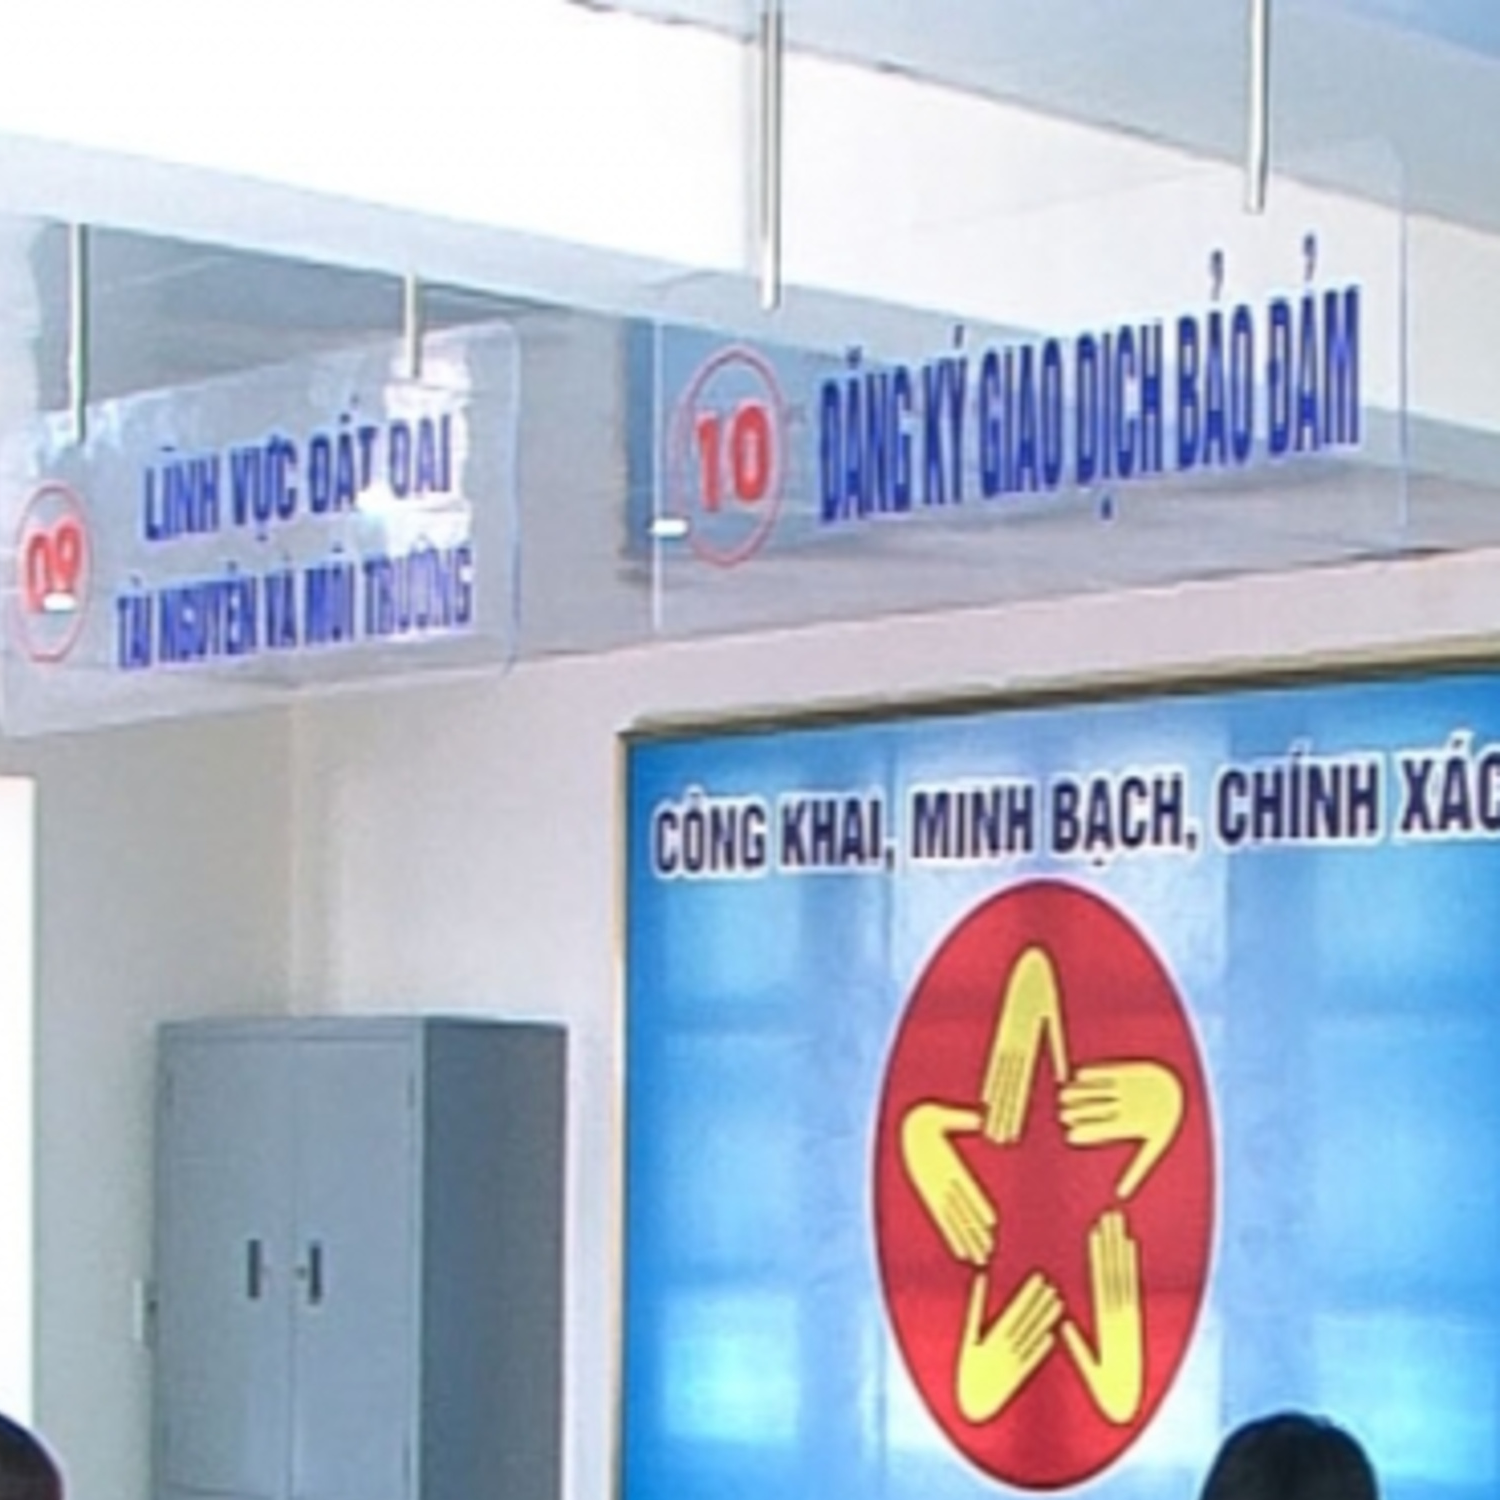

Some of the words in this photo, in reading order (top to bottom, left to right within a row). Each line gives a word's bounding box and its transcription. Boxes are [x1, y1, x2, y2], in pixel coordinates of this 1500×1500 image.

[697, 403, 771, 513] 10
[820, 346, 912, 523] ĐĂNG
[922, 324, 968, 505] KÝ
[980, 337, 1063, 500] GIAO
[1075, 324, 1163, 520] DỊCH
[1176, 249, 1254, 471] BẢO
[1267, 233, 1359, 455] ĐẢM
[145, 446, 220, 541] LĨNH
[230, 433, 297, 542] VỰC
[26, 525, 82, 613] 09
[657, 790, 767, 873] CÔNG
[781, 797, 897, 871] KHAI,
[911, 783, 1035, 860] MINH
[1052, 772, 1199, 867] BẠCH,
[1218, 747, 1379, 845] CHÍNH
[1400, 737, 1500, 832] XÁC
